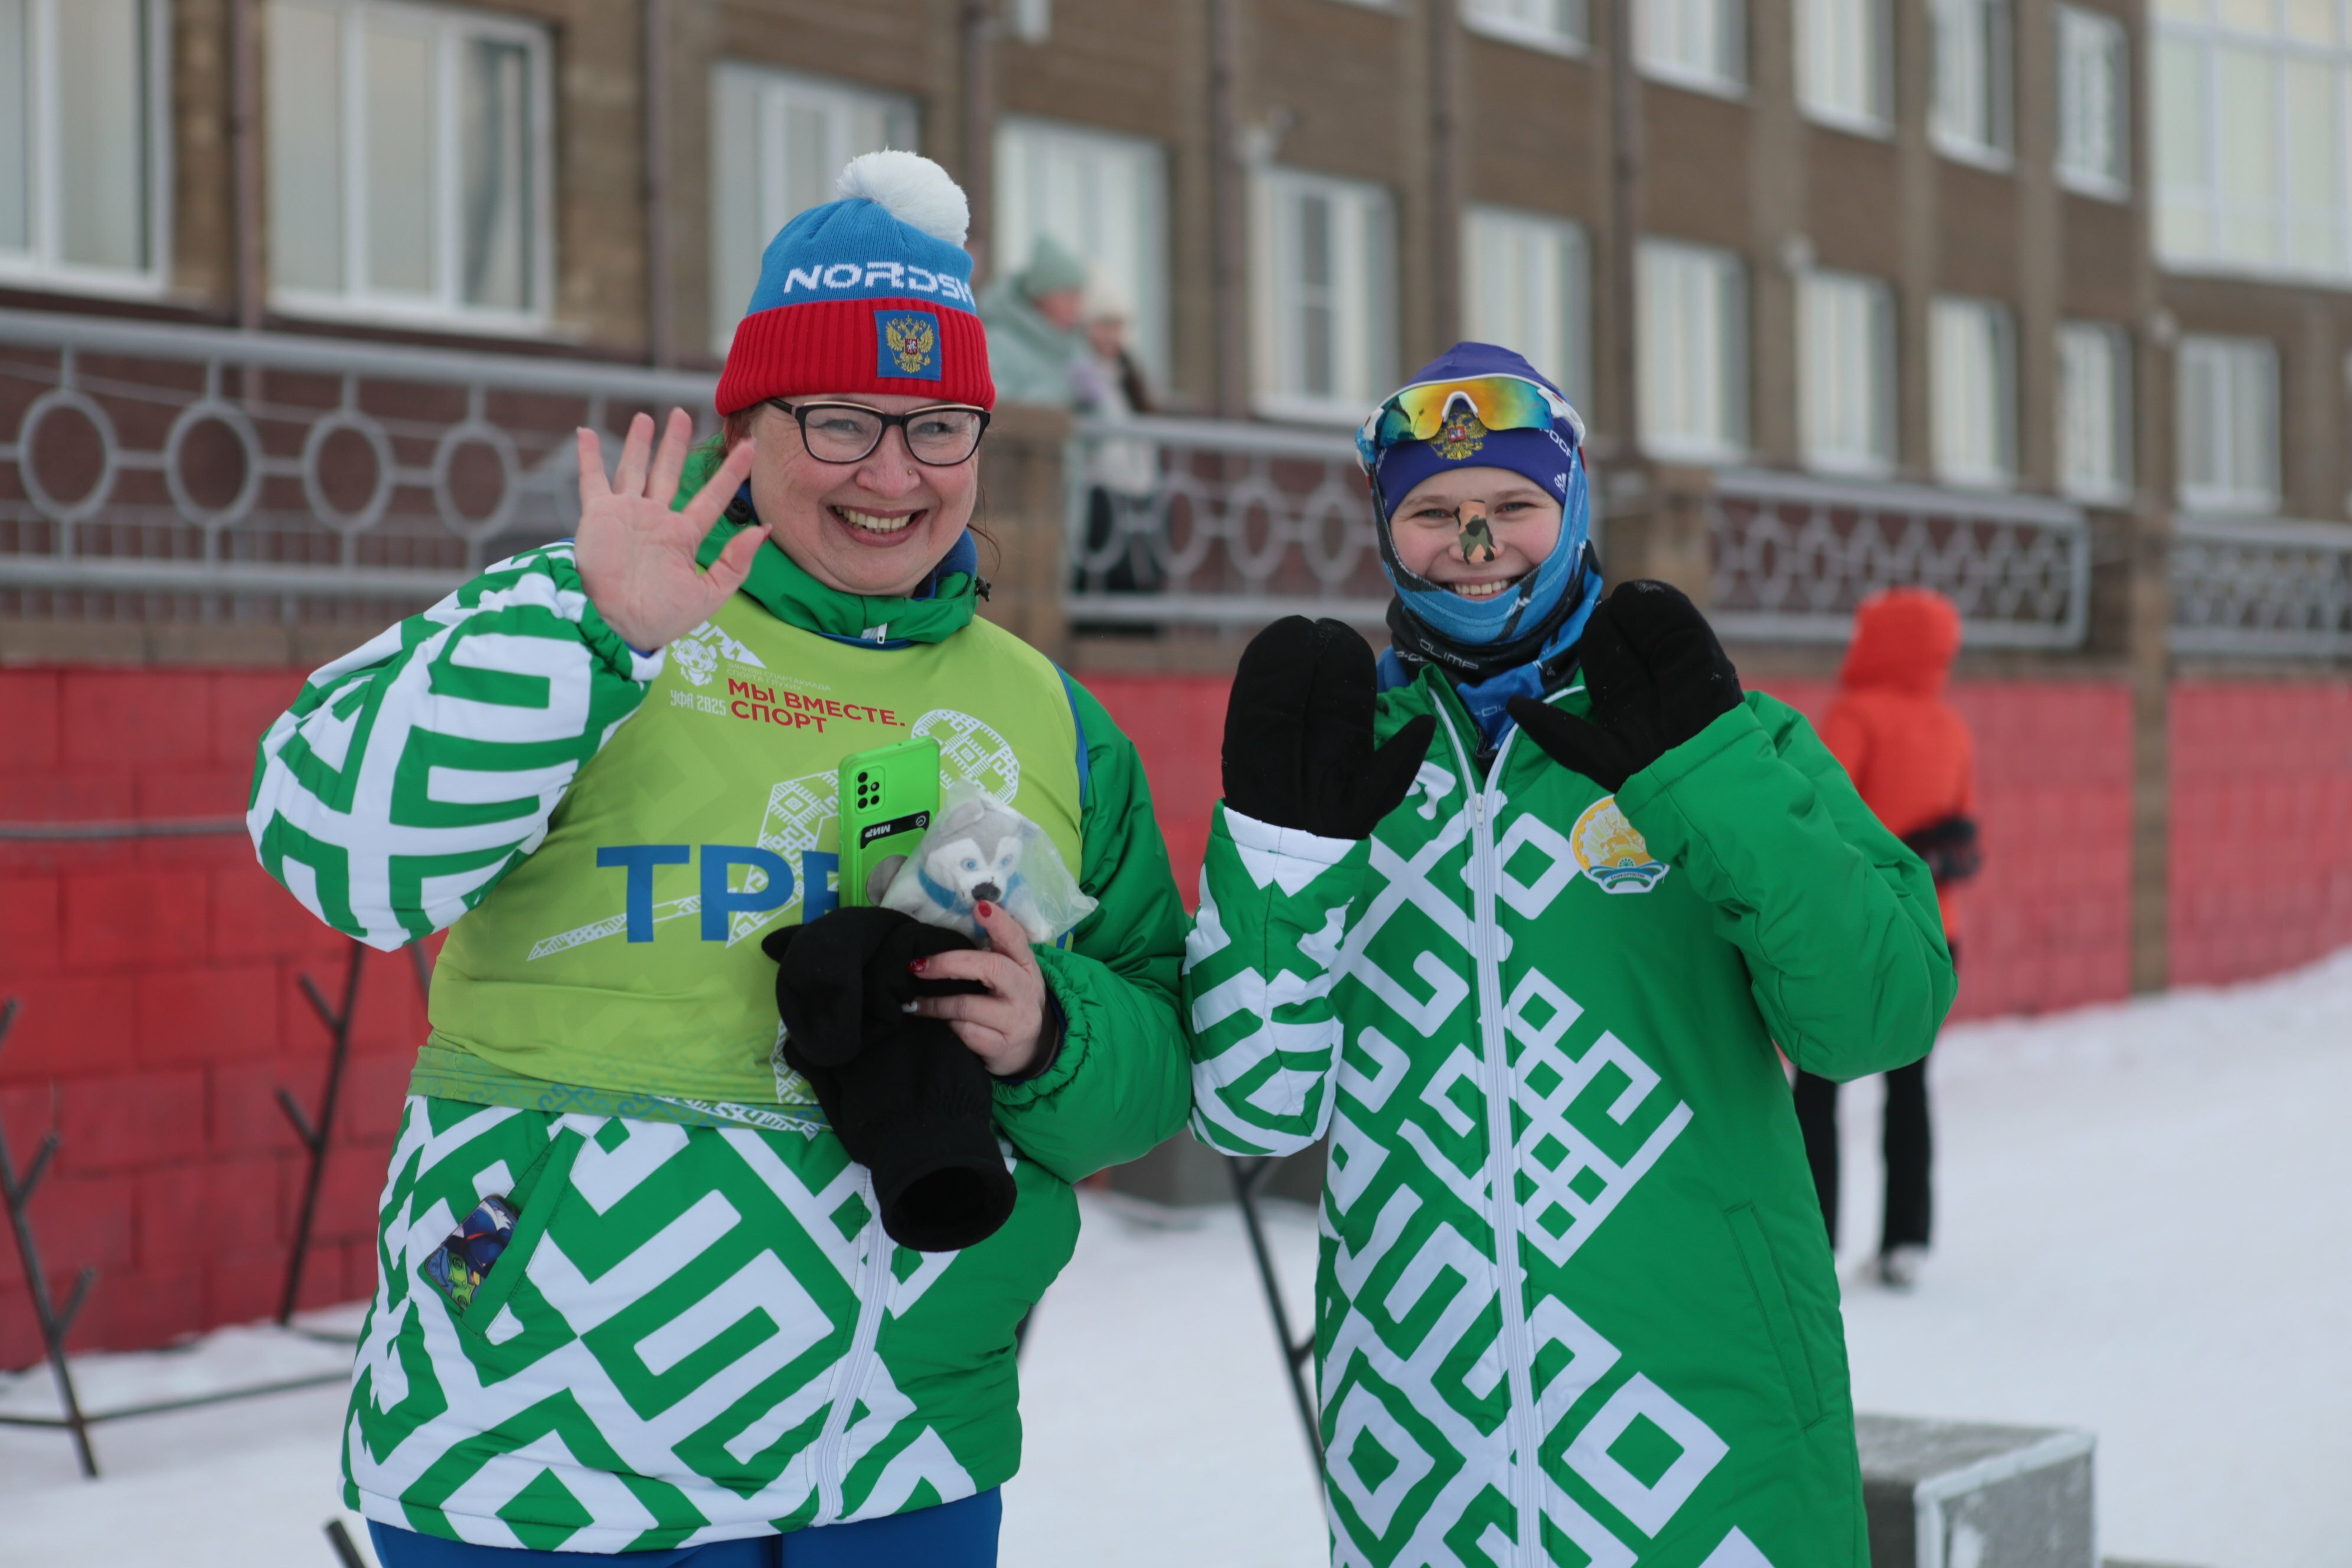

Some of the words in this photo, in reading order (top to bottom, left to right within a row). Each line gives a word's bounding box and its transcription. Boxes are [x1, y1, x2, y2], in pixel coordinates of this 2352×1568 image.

[670, 689, 694, 709] УФА
[697, 695, 727, 716] 2025
[728, 678, 776, 704] МЫ
[783, 691, 906, 727] ВМЕСТЕ.
[731, 700, 827, 733] СПОРТ
